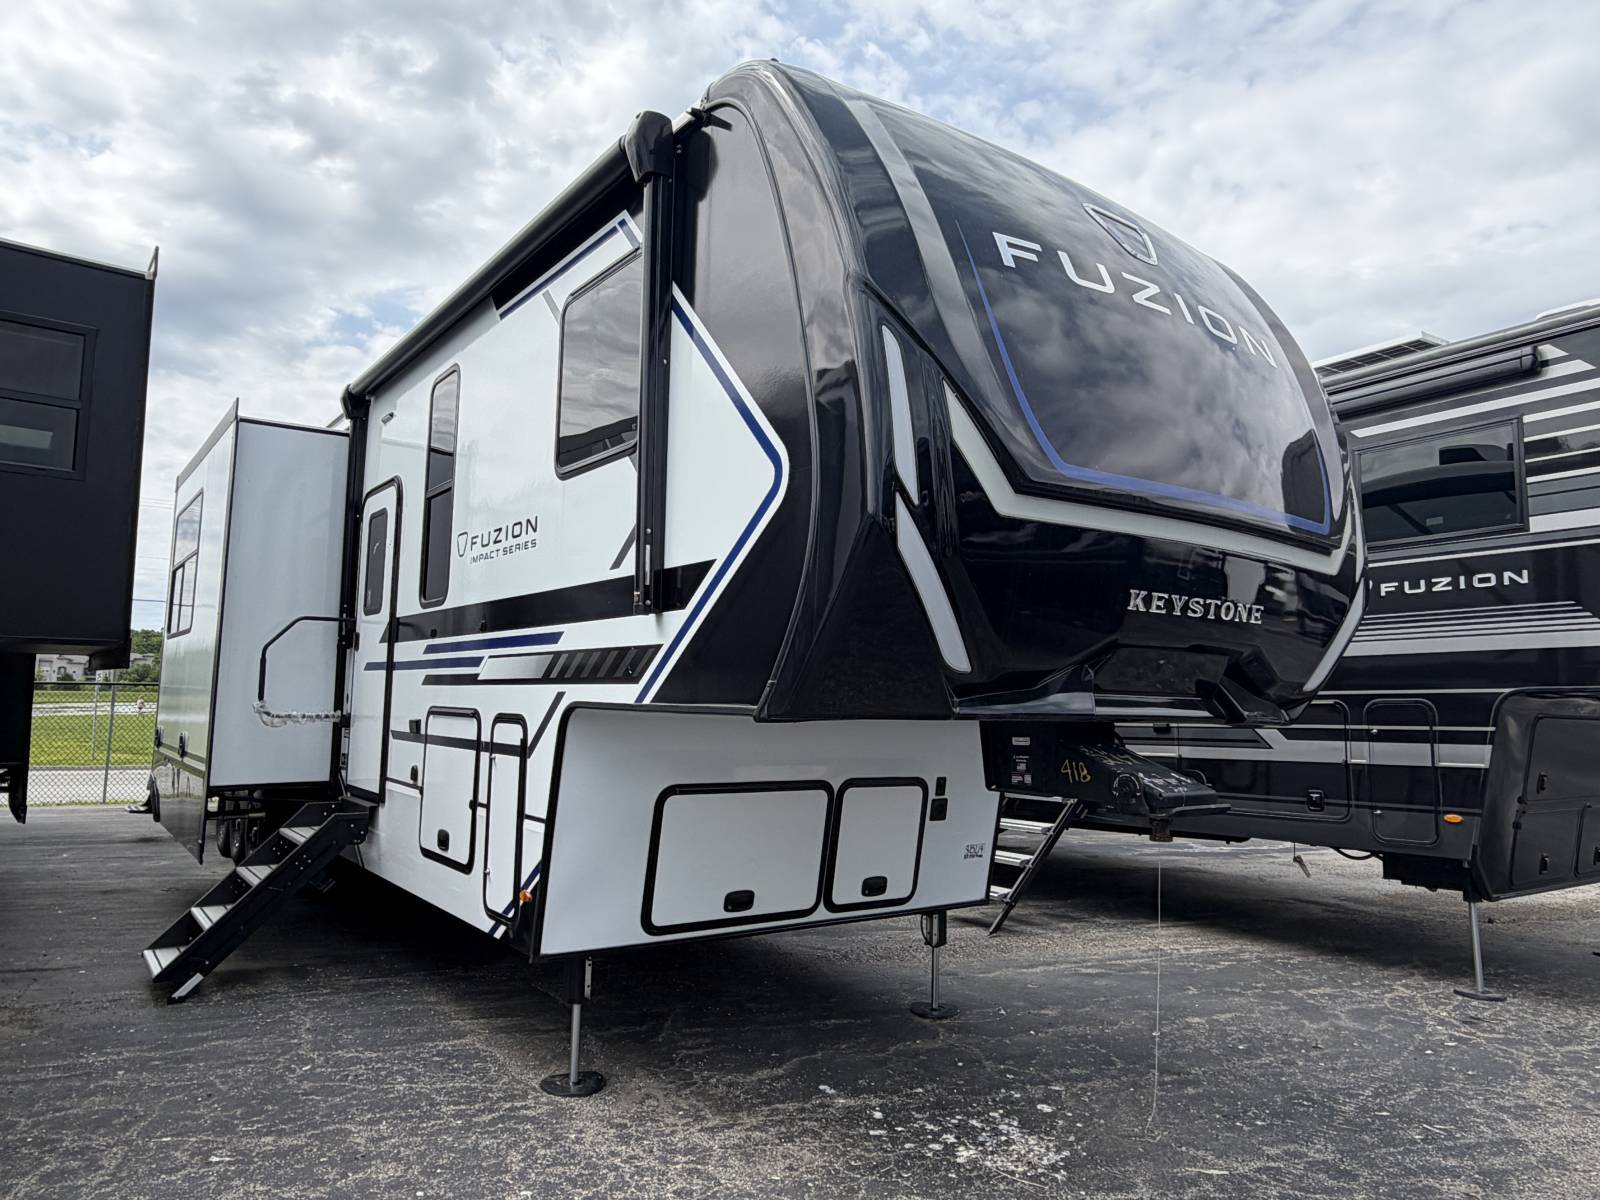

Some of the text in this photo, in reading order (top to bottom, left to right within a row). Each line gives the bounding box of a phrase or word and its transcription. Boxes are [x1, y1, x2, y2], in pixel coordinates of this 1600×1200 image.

[992, 231, 1277, 369] FUZION
[470, 515, 538, 552] FUZION
[470, 538, 537, 564] IMPACT SERIES
[1380, 569, 1529, 597] FUZION
[1127, 589, 1265, 625] KEYSTONE
[1060, 759, 1092, 784] 418
